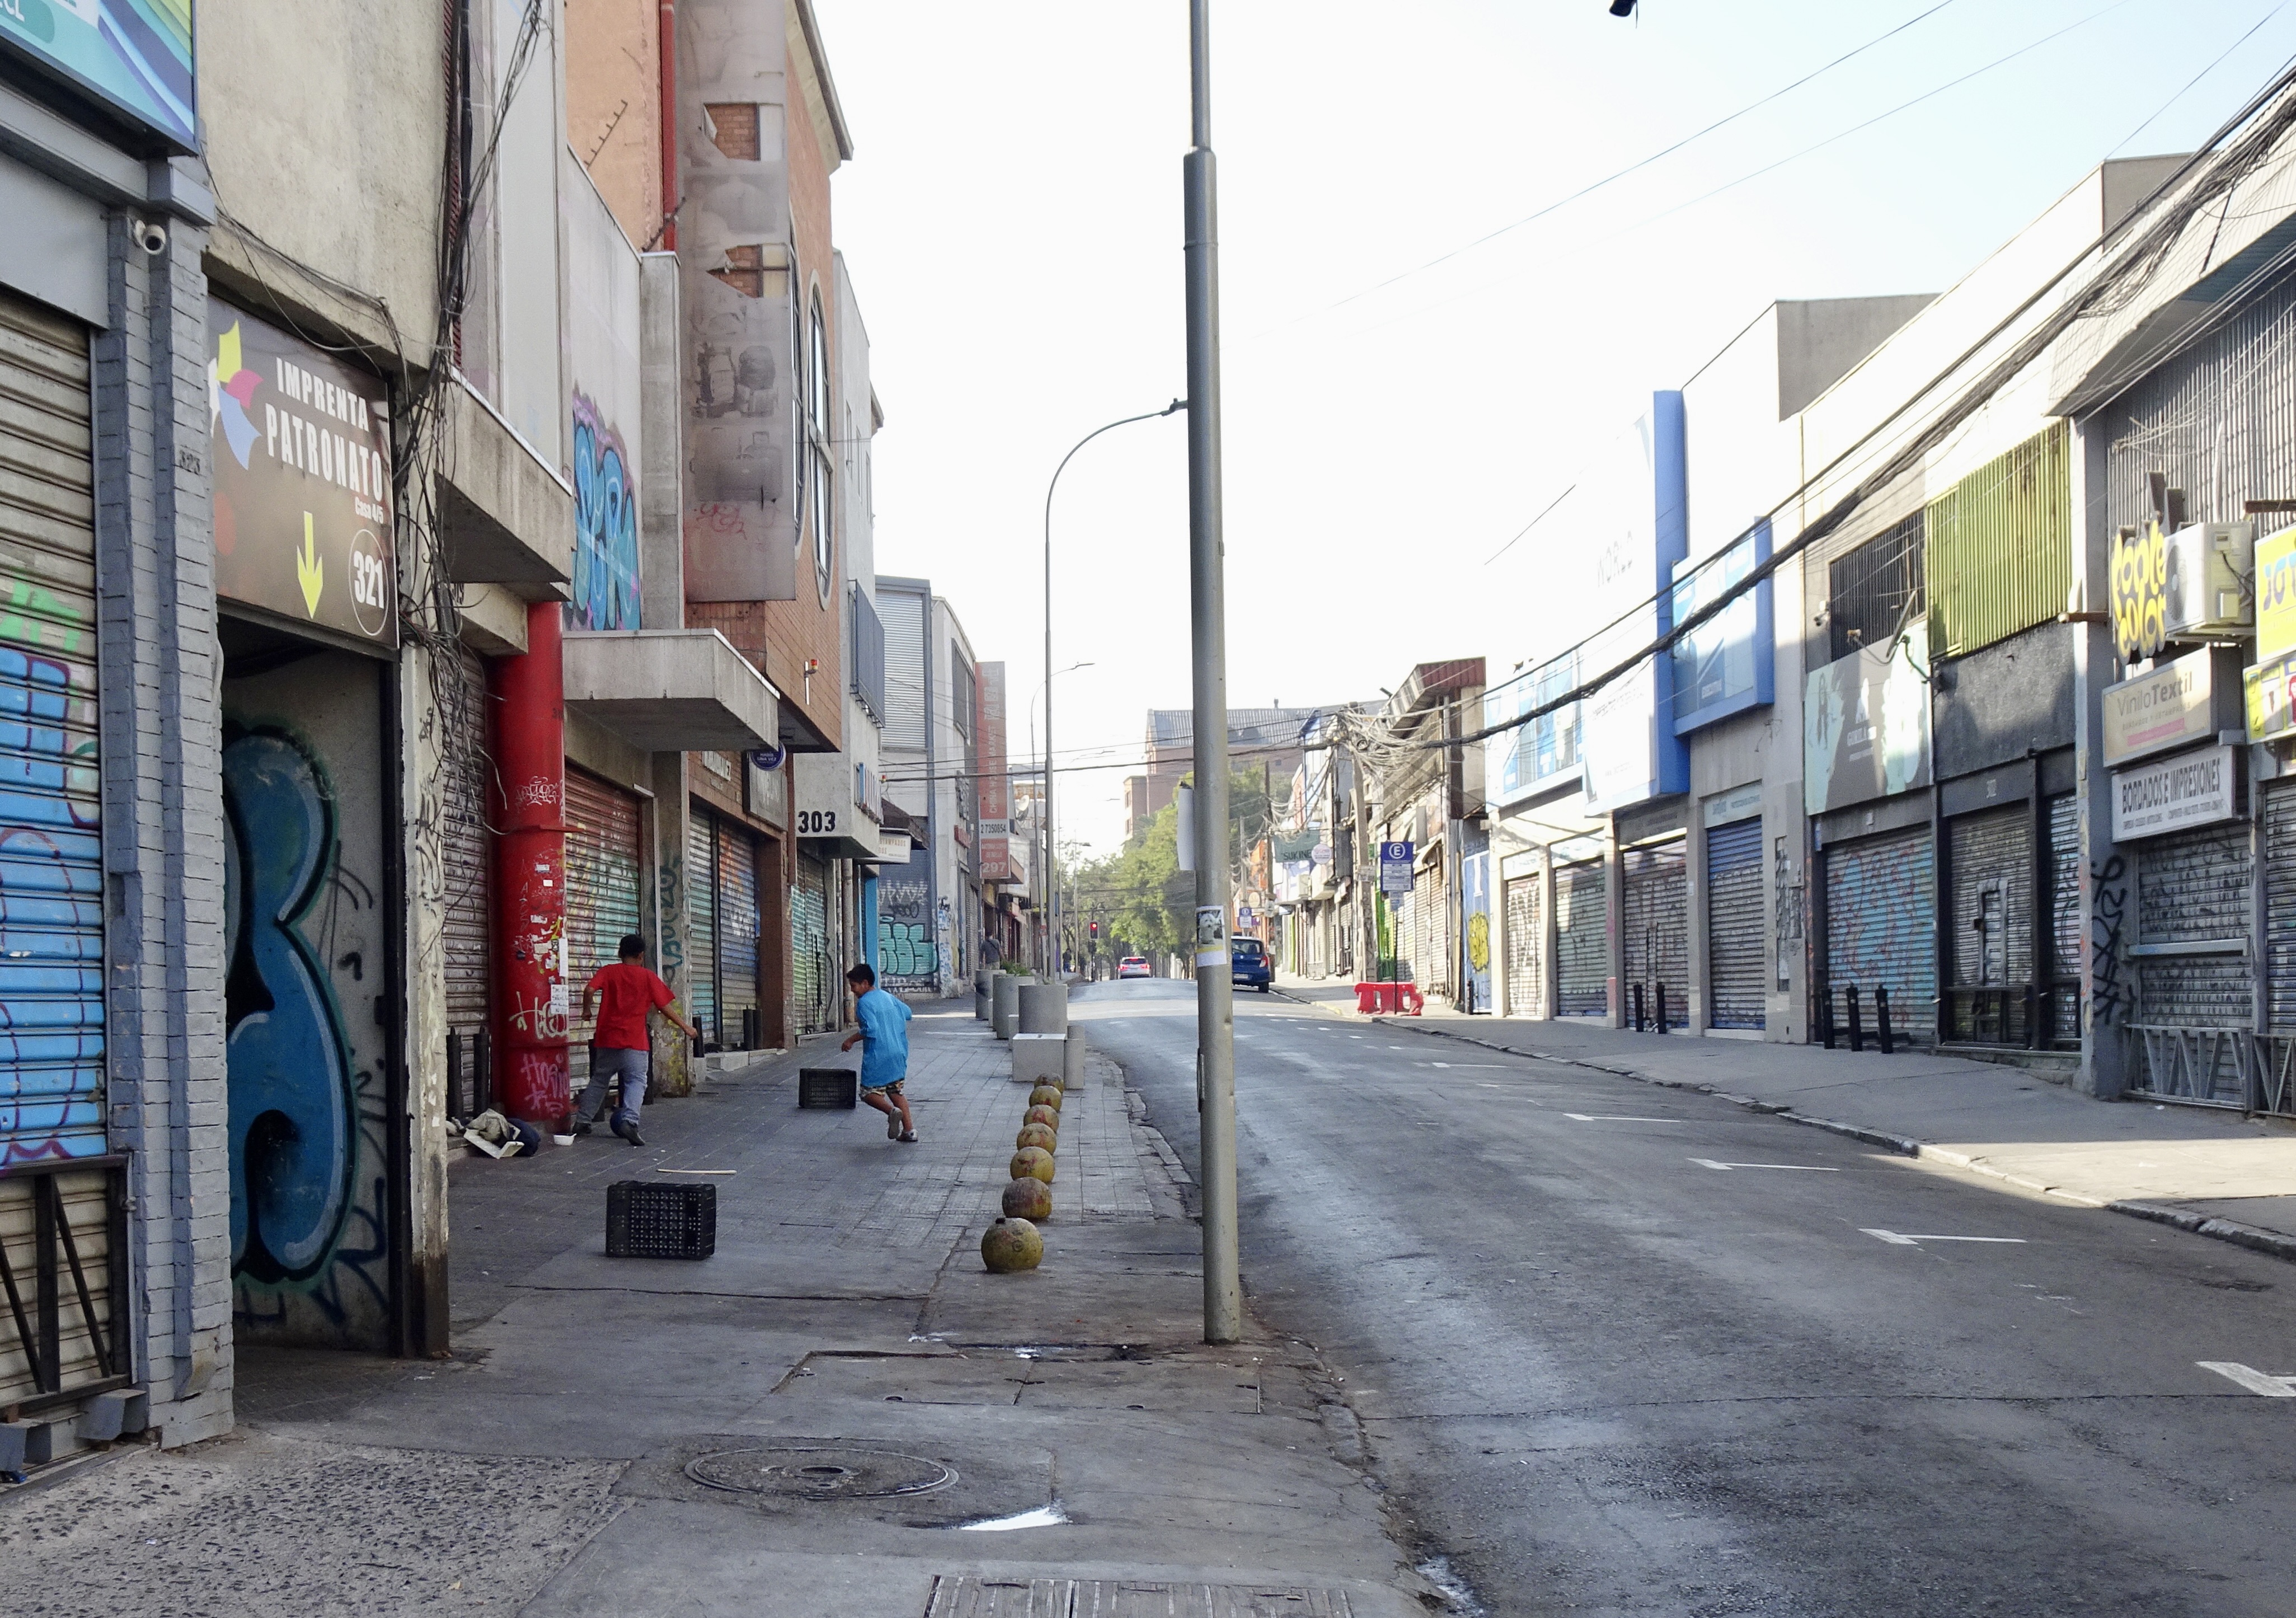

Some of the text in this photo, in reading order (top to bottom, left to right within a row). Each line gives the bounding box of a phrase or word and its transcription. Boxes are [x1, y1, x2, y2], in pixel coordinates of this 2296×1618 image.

[276, 357, 369, 433] IMPRENTA
[265, 402, 383, 502] PATRONATO
[372, 504, 384, 524] 4/5
[354, 550, 384, 609] 321
[2117, 671, 2192, 717] ViniloTextil
[988, 725, 997, 756] MARKET
[989, 759, 997, 788] HOUSE
[2123, 773, 2163, 814] BORDADOS
[2164, 772, 2169, 804] E
[2170, 757, 2221, 803] IMPRESIONES
[989, 789, 998, 814] CHINA
[798, 811, 836, 833] 303
[980, 824, 984, 834] 2
[1393, 846, 1401, 856] E
[982, 862, 1007, 873] 297
